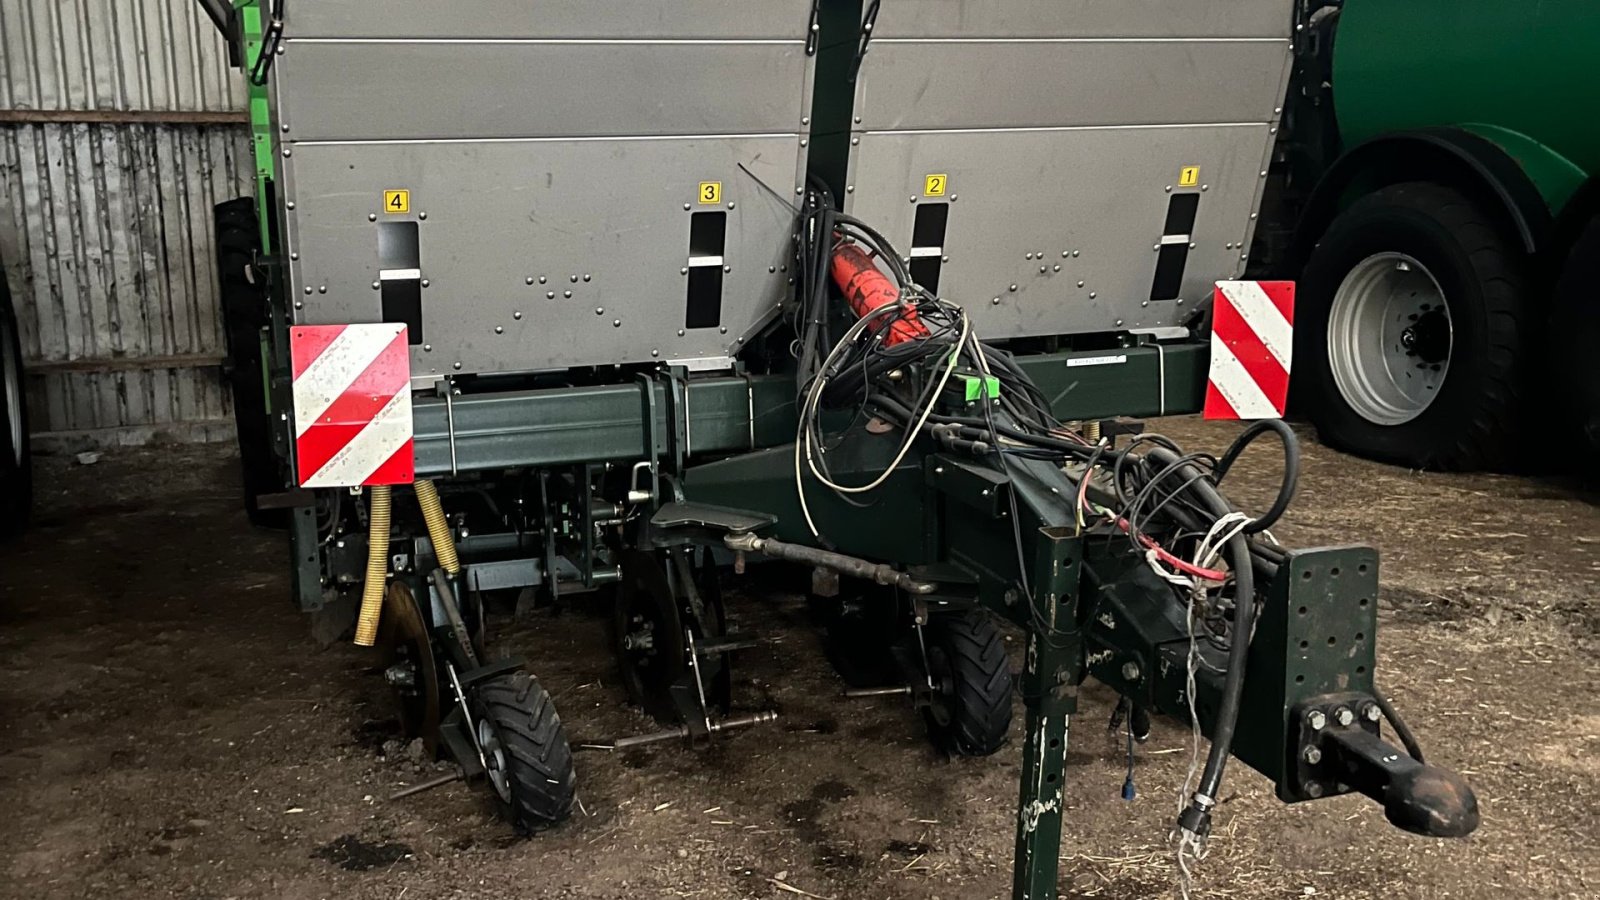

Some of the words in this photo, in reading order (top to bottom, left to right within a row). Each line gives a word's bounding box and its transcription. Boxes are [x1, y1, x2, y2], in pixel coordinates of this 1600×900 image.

[1186, 169, 1193, 183] 1
[704, 185, 715, 200] 3
[930, 178, 940, 193] 2
[390, 193, 402, 209] 4
